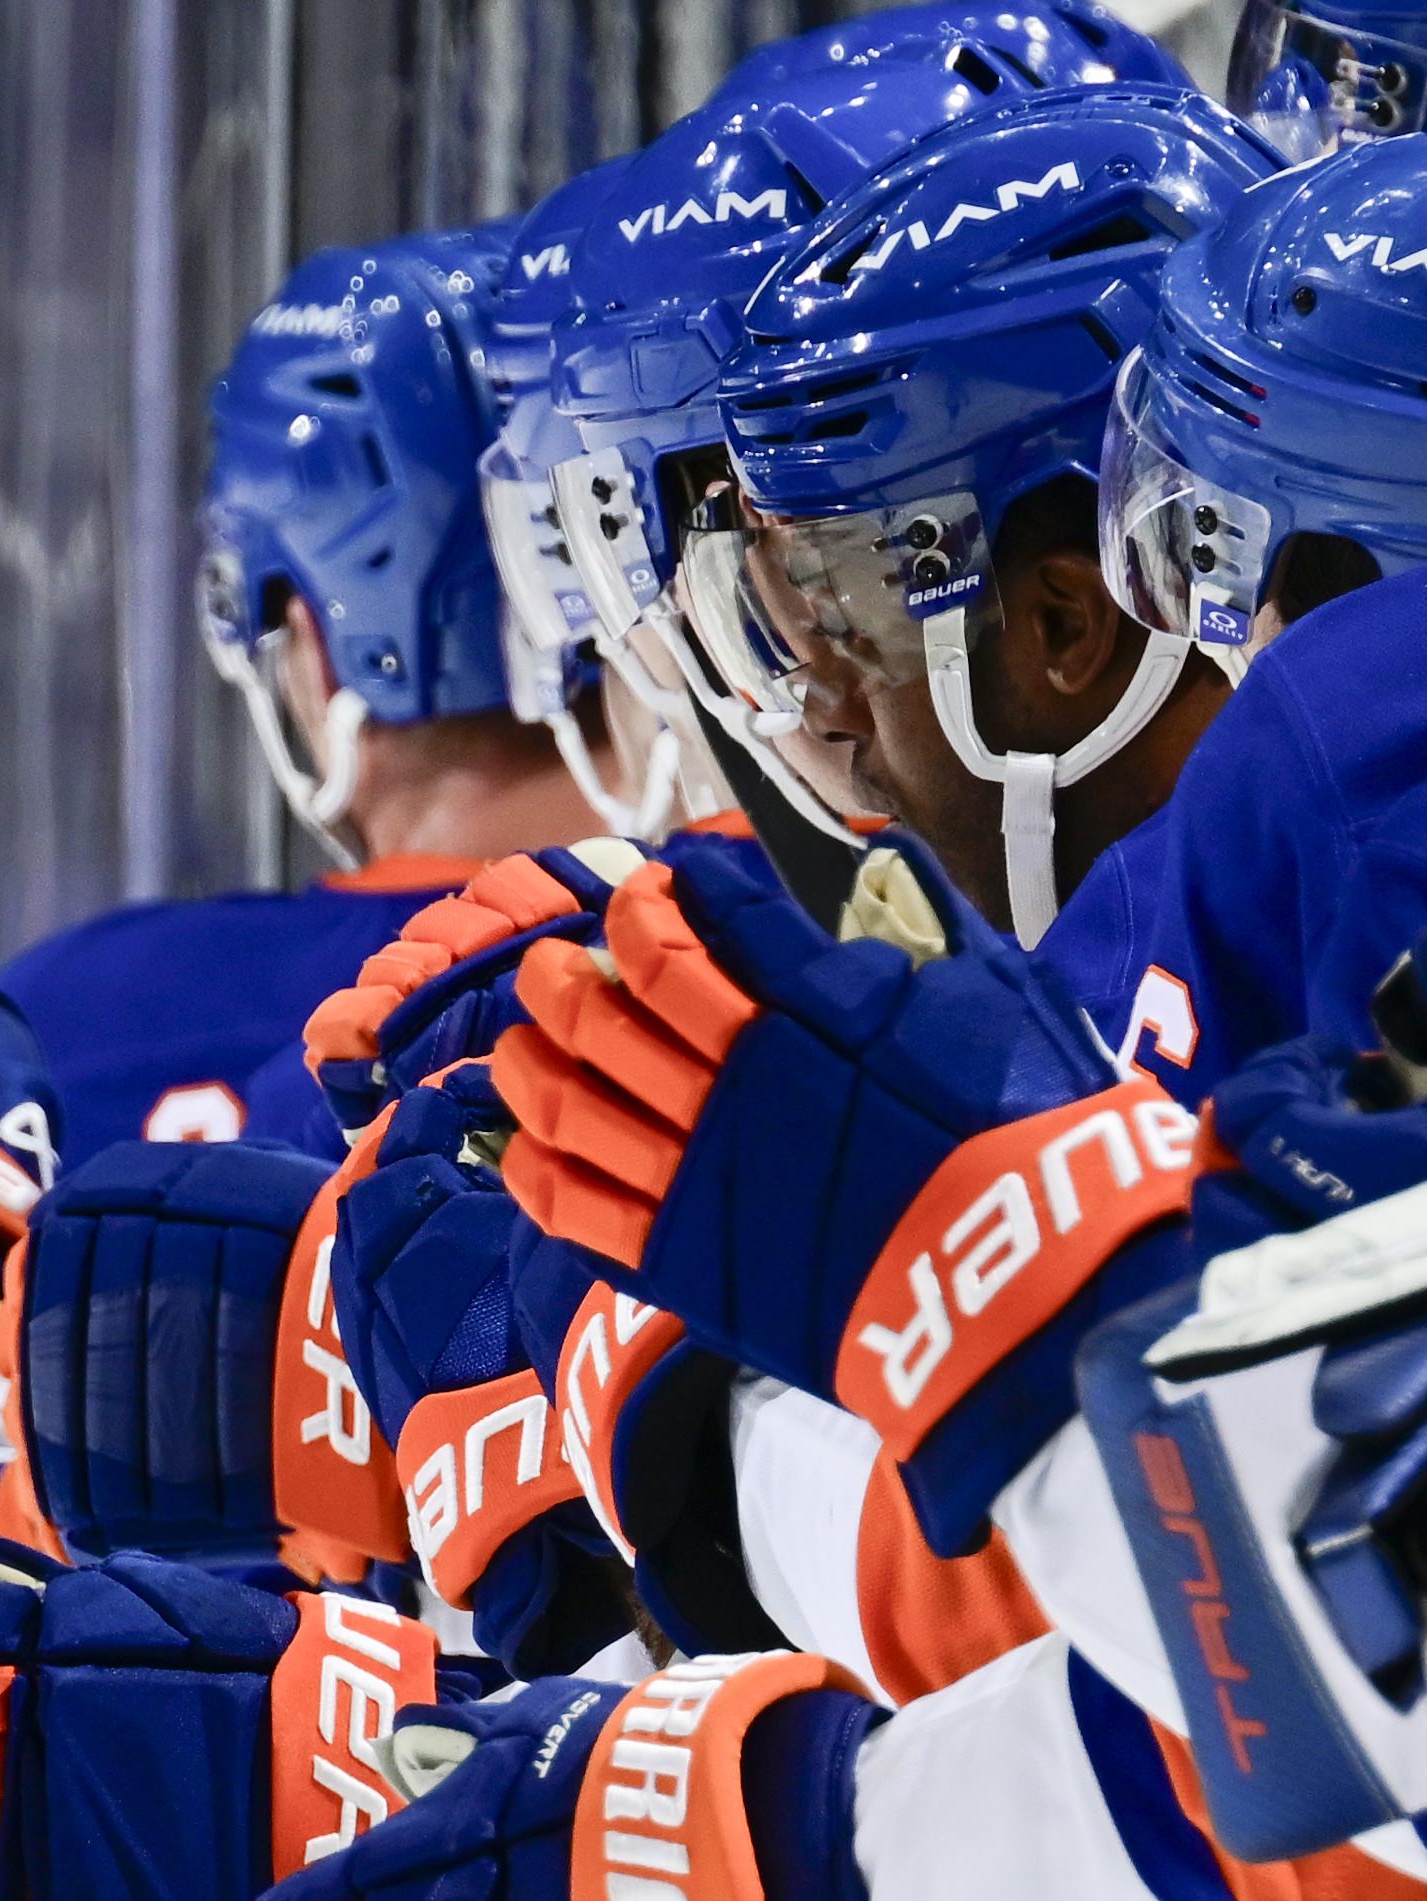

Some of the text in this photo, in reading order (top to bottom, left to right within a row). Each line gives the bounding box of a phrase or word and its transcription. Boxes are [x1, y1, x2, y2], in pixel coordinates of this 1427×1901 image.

[618, 189, 787, 243] VIAM
[850, 162, 1081, 270] VIAM
[908, 574, 980, 606] BAUER
